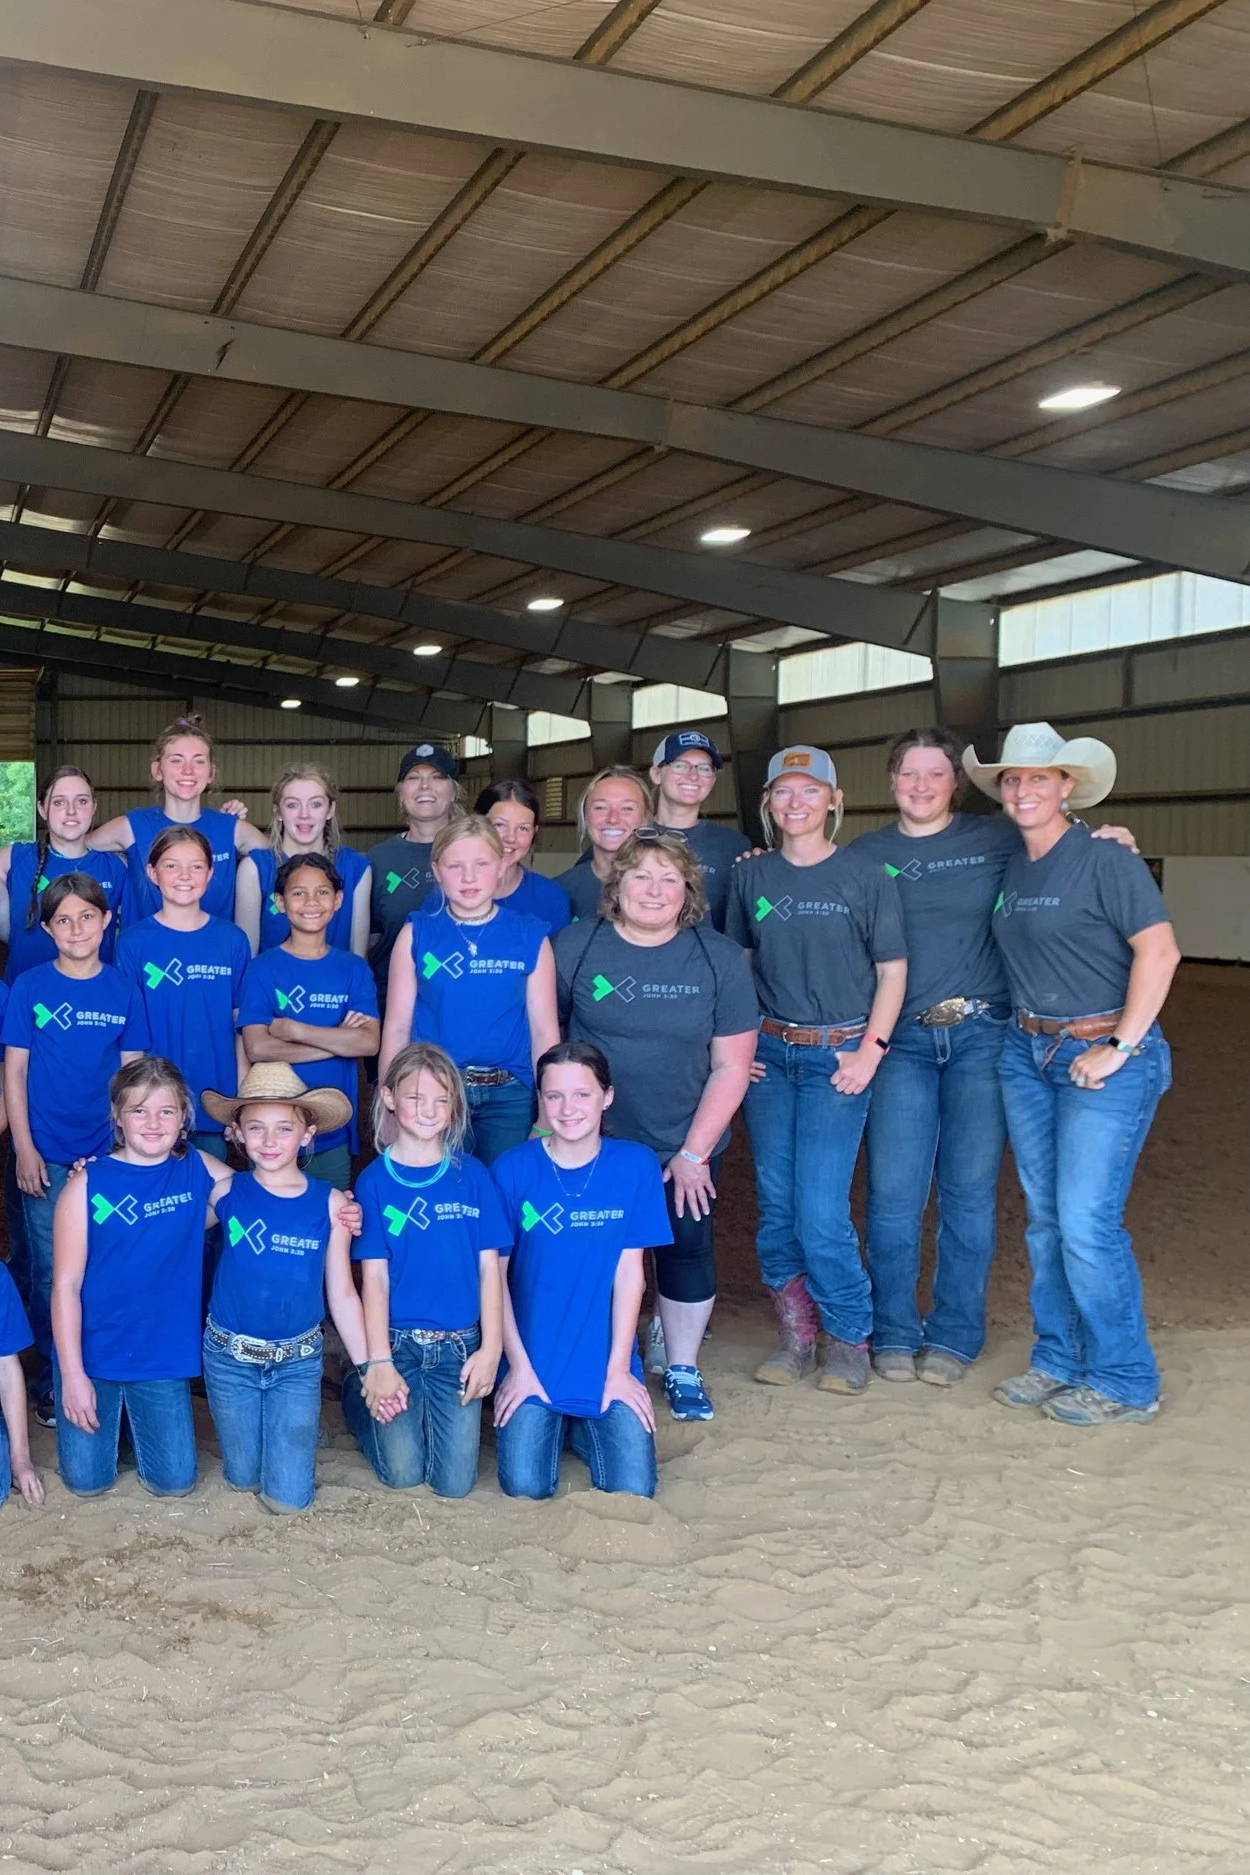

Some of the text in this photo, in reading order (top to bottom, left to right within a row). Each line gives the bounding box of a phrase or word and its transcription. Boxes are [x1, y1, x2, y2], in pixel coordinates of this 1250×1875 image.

[927, 856, 985, 869] GREATER
[470, 960, 525, 970] GREATER
[642, 984, 699, 994] GREATER
[76, 1011, 126, 1025] GREATER
[435, 1202, 480, 1218] GRETER
[570, 1210, 624, 1221] GREATER
[271, 1234, 321, 1250] GREATE
[271, 1245, 288, 1253] JOHN
